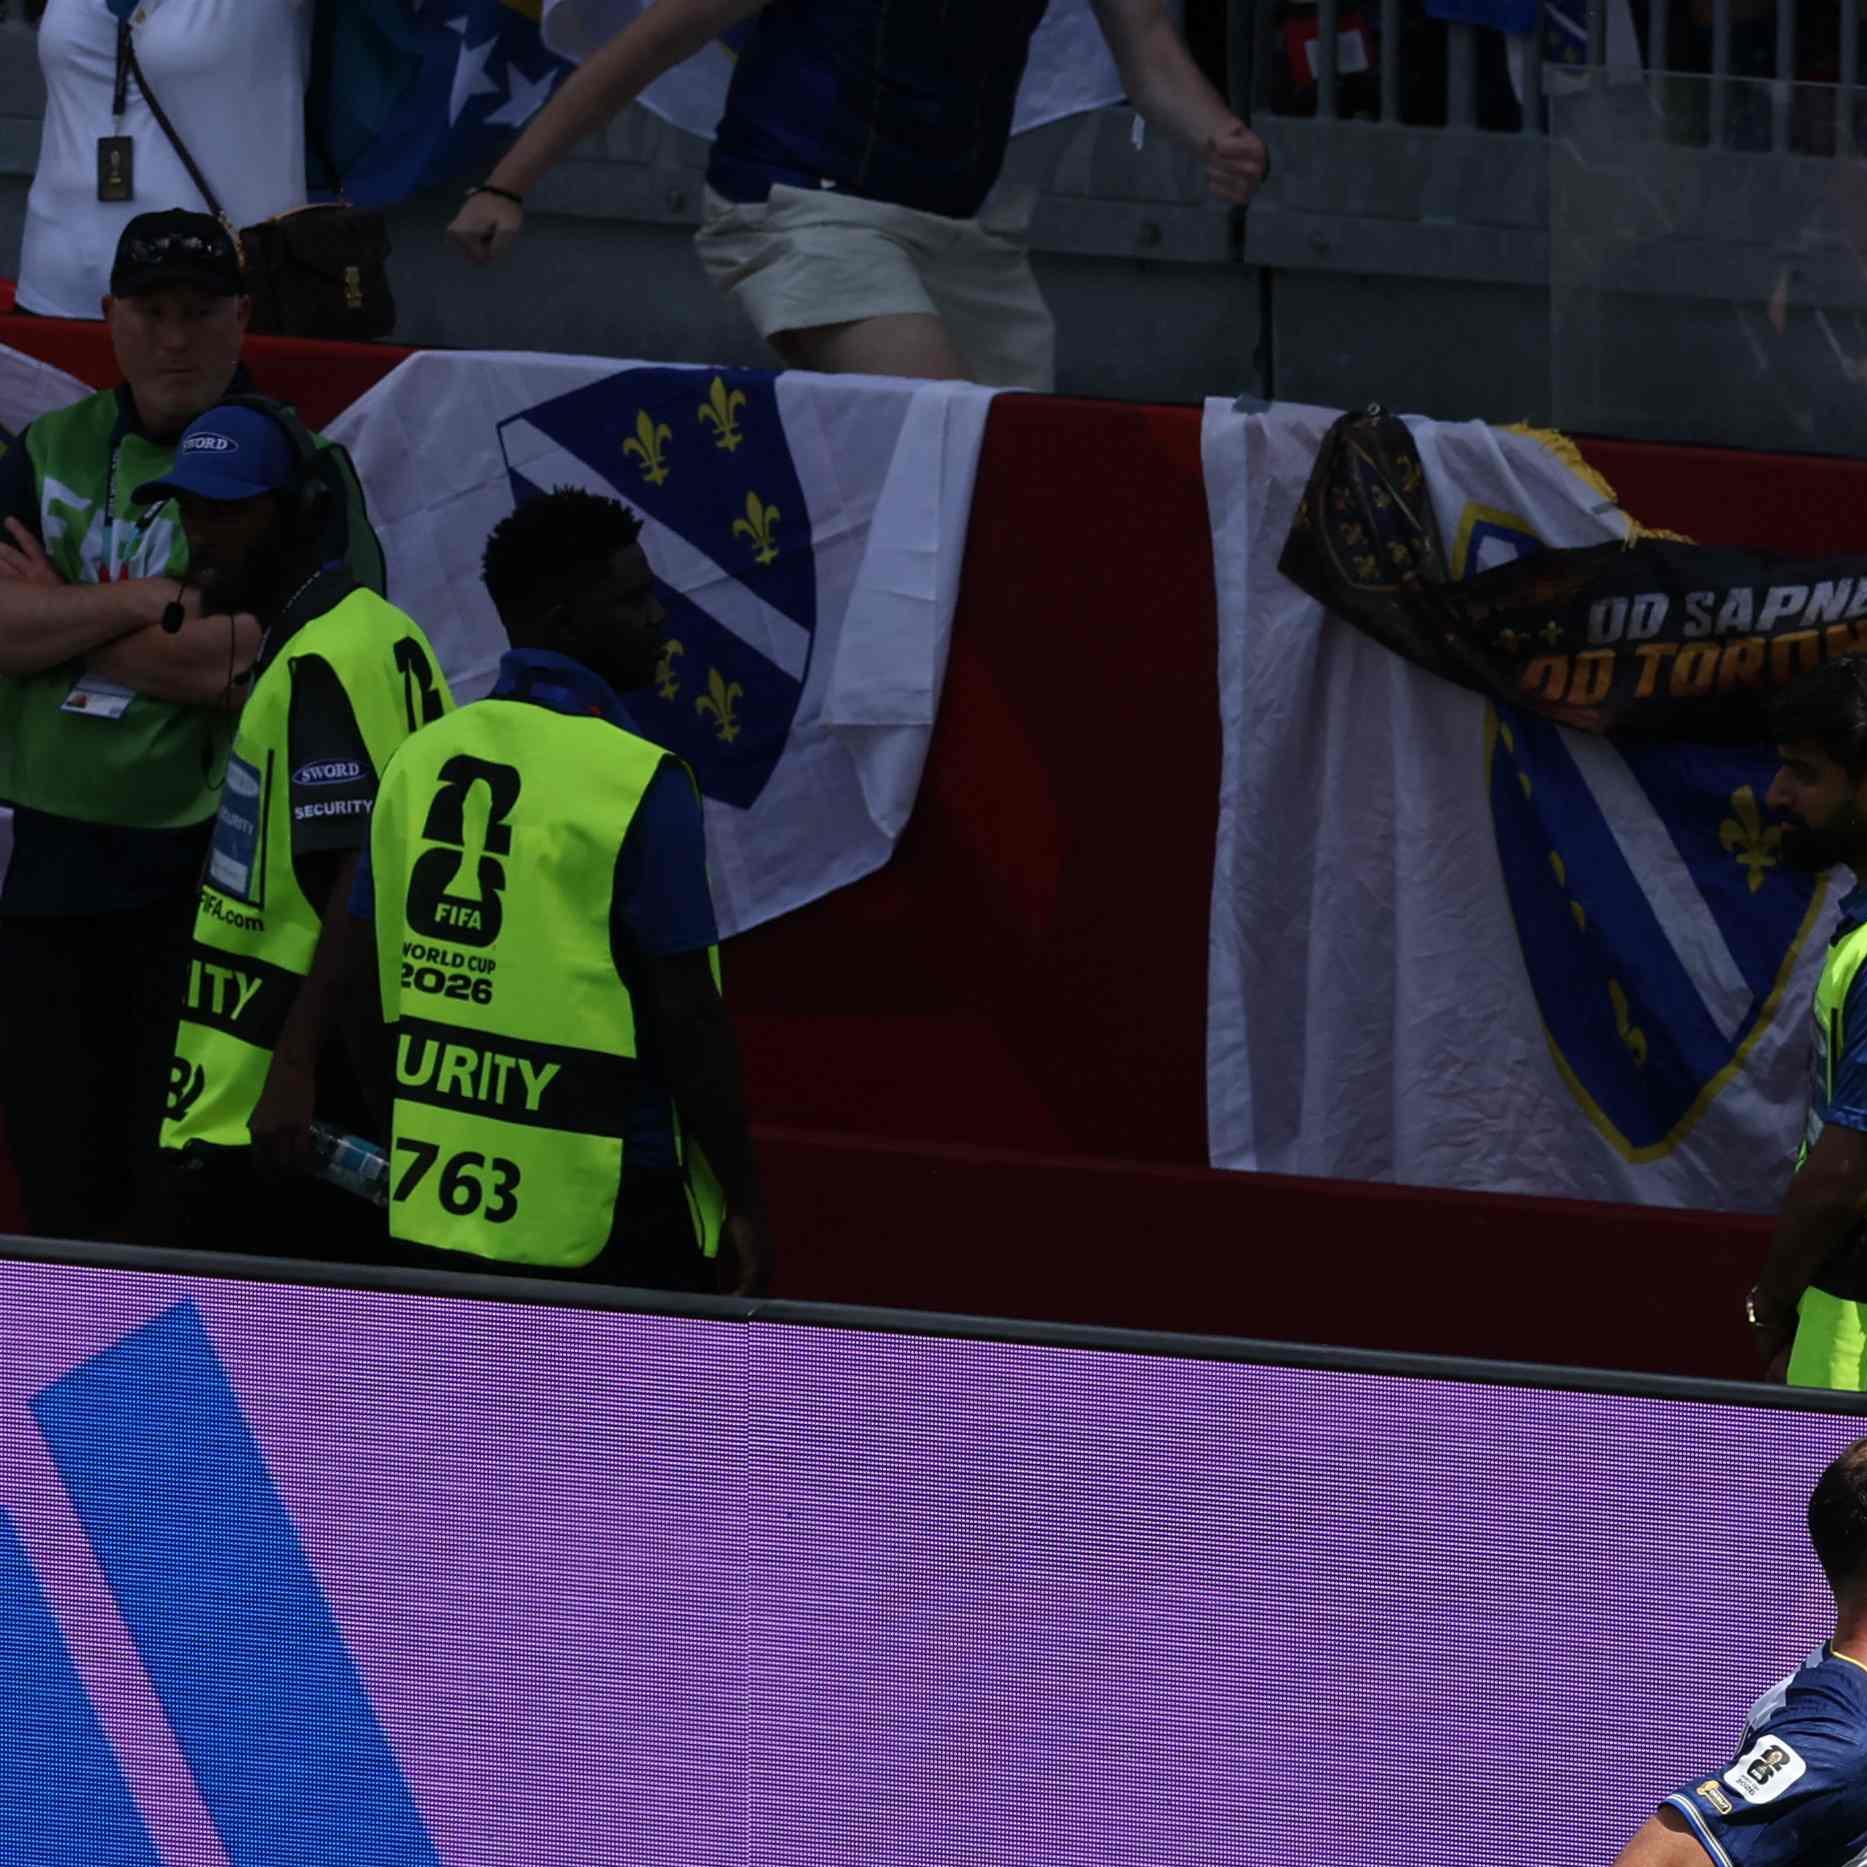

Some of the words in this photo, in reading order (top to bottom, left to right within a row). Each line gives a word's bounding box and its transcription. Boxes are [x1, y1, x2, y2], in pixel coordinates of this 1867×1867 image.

[1585, 592, 1671, 645] OD
[300, 761, 362, 782] SWORD
[294, 800, 375, 820] SECURITY
[432, 901, 485, 932] FIFA
[467, 952, 498, 975] CUP
[402, 961, 494, 1005] 2026
[393, 1137, 522, 1224] 763
